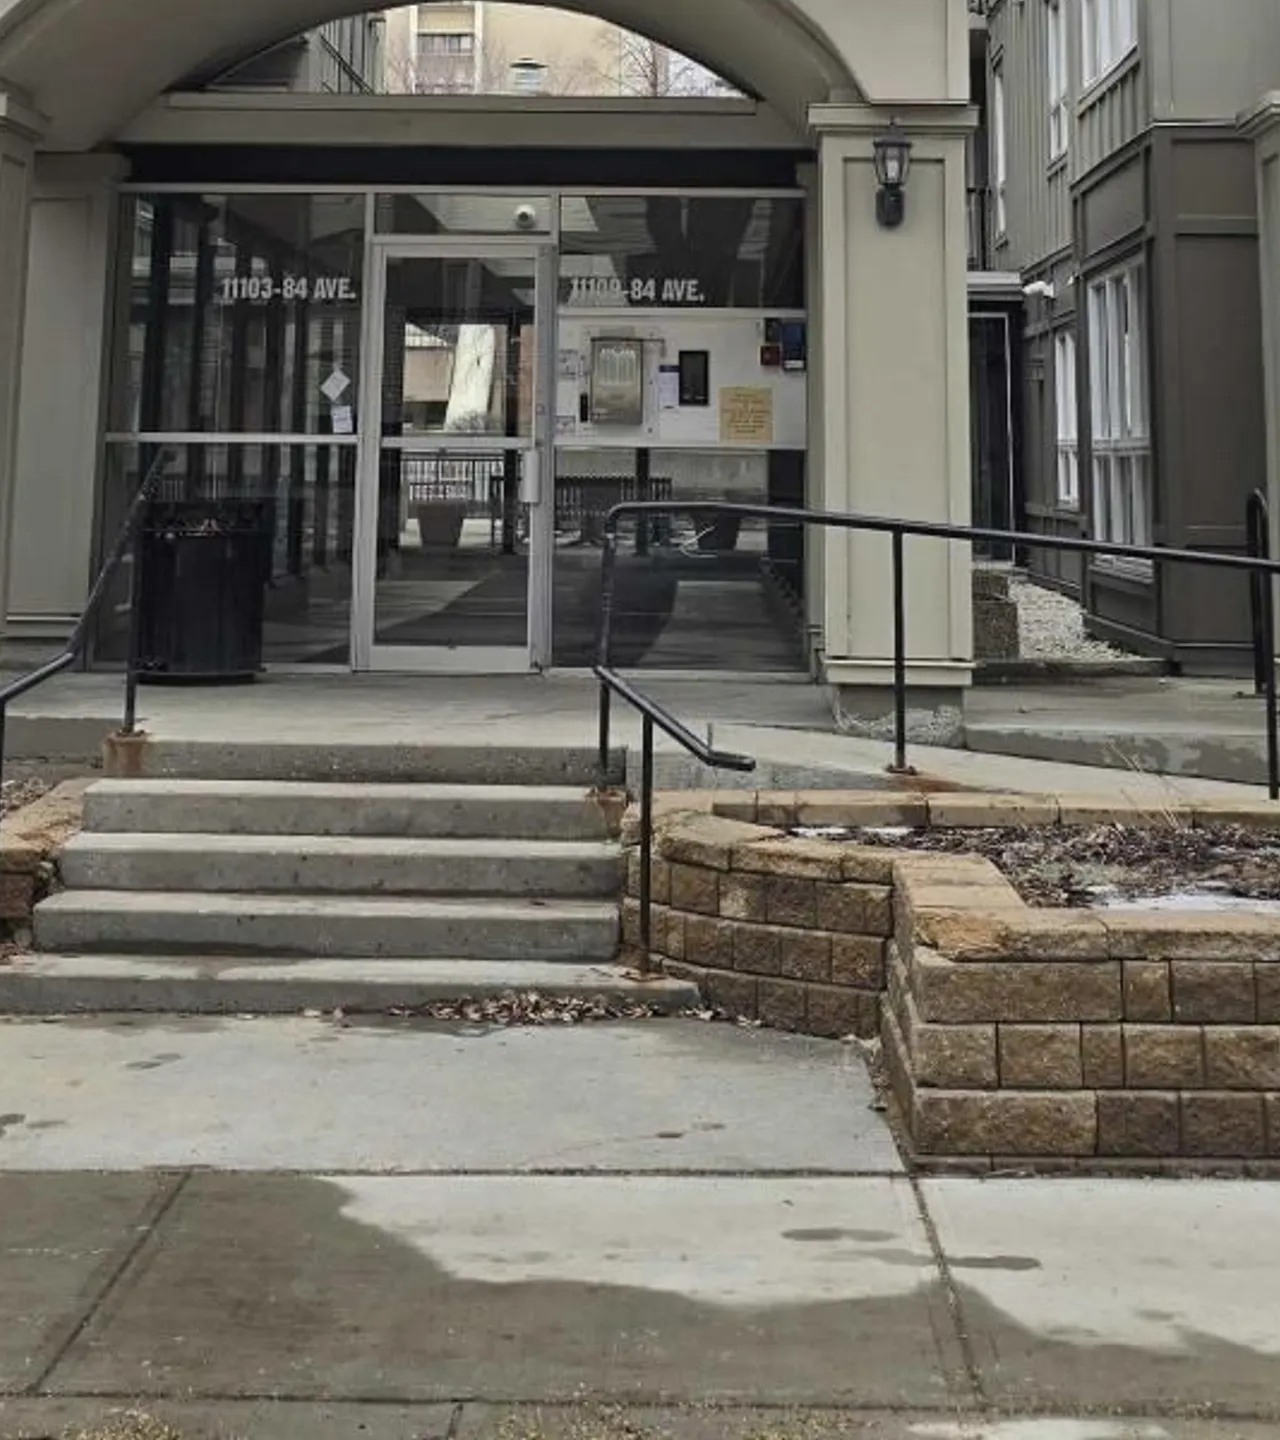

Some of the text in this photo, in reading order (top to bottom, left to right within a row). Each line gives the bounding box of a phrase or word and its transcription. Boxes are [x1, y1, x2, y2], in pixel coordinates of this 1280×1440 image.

[221, 276, 357, 299] 11103-84 AVE.
[661, 278, 705, 302] AVE.
